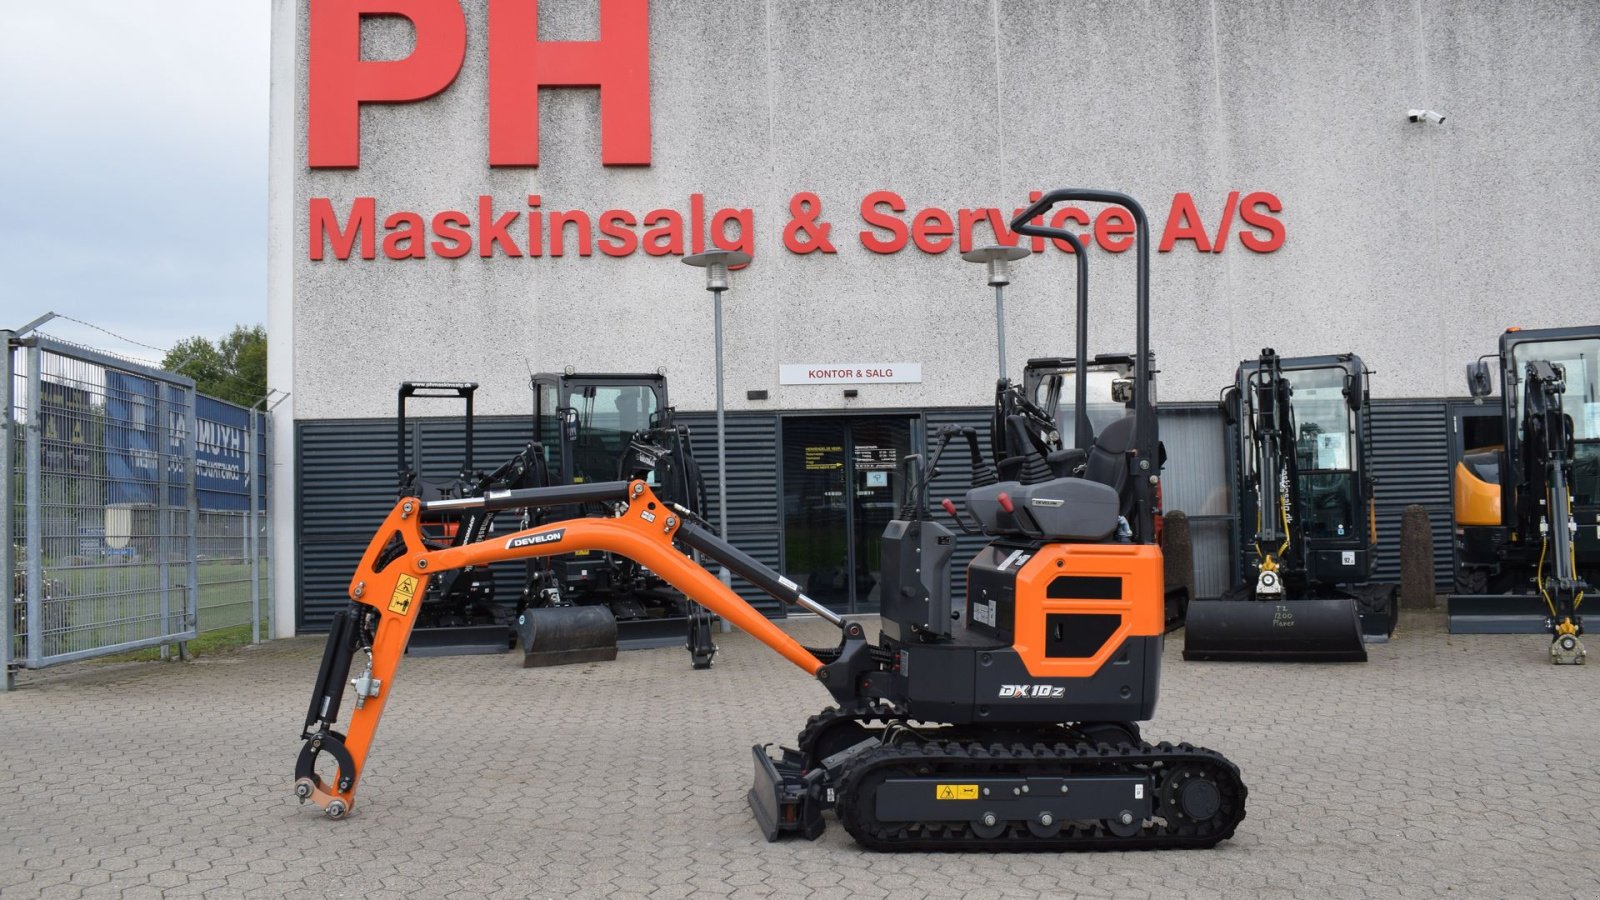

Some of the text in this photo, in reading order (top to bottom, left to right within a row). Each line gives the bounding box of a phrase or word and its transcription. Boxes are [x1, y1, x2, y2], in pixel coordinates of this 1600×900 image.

[308, 0, 652, 168] PH
[309, 190, 1287, 272] Maskinsalg & Service A/S
[808, 368, 894, 379] KONTOR & SALG
[513, 532, 562, 548] DEVELON
